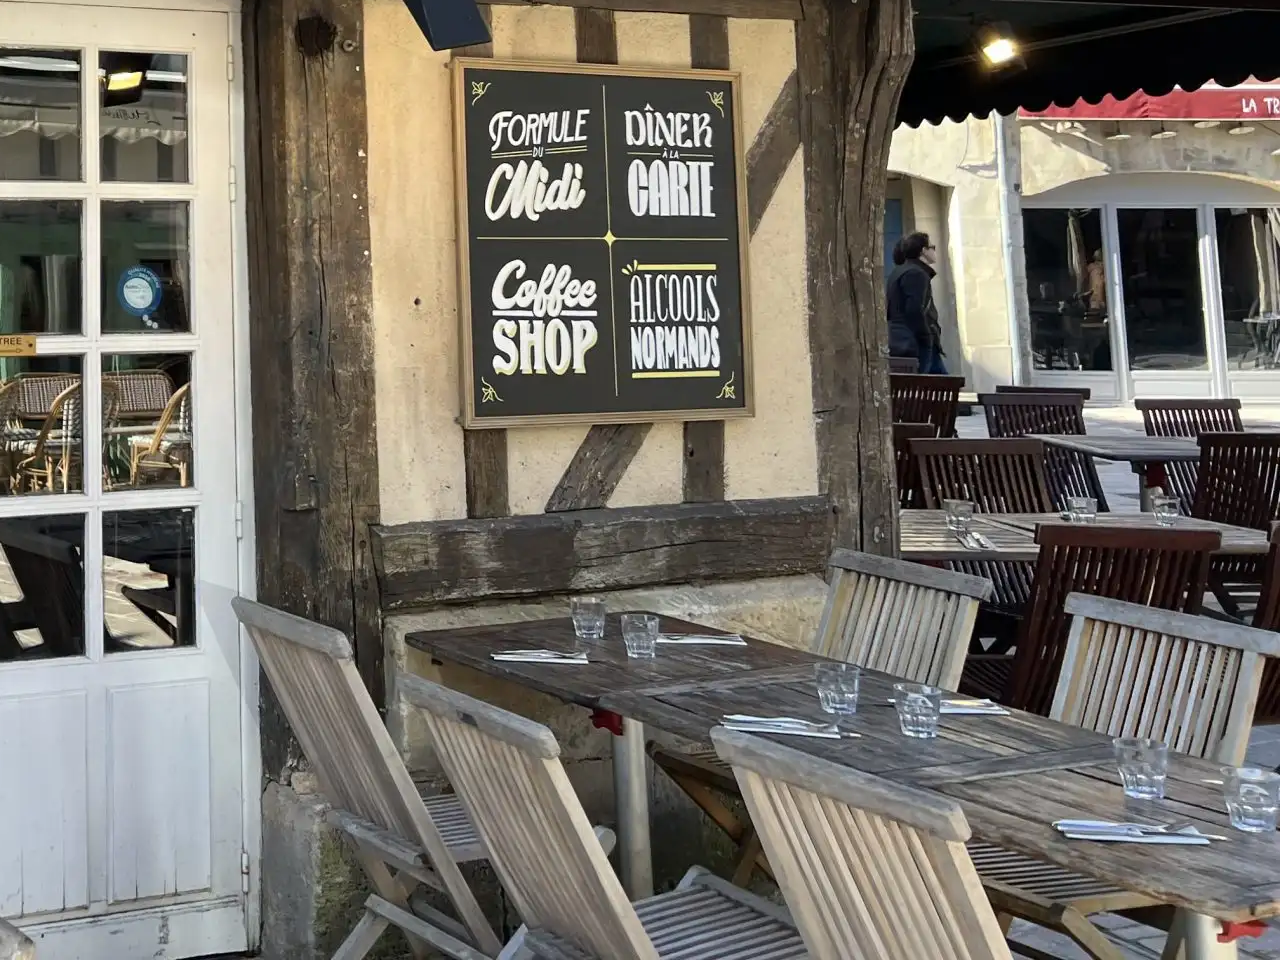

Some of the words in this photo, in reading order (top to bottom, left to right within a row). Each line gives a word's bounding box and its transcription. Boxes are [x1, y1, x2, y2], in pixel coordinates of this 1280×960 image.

[624, 103, 713, 148] DÎNER
[1242, 97, 1257, 113] LA
[488, 109, 590, 151] FORMULE
[532, 147, 544, 158] DU
[662, 148, 669, 158] À
[670, 149, 679, 159] LA
[484, 159, 587, 221] Midi
[627, 158, 716, 217] CARTE
[491, 259, 597, 317] Coffee
[630, 274, 720, 323] ALCOOLS
[492, 318, 598, 375] SHOP
[630, 325, 720, 370] NORMANDS
